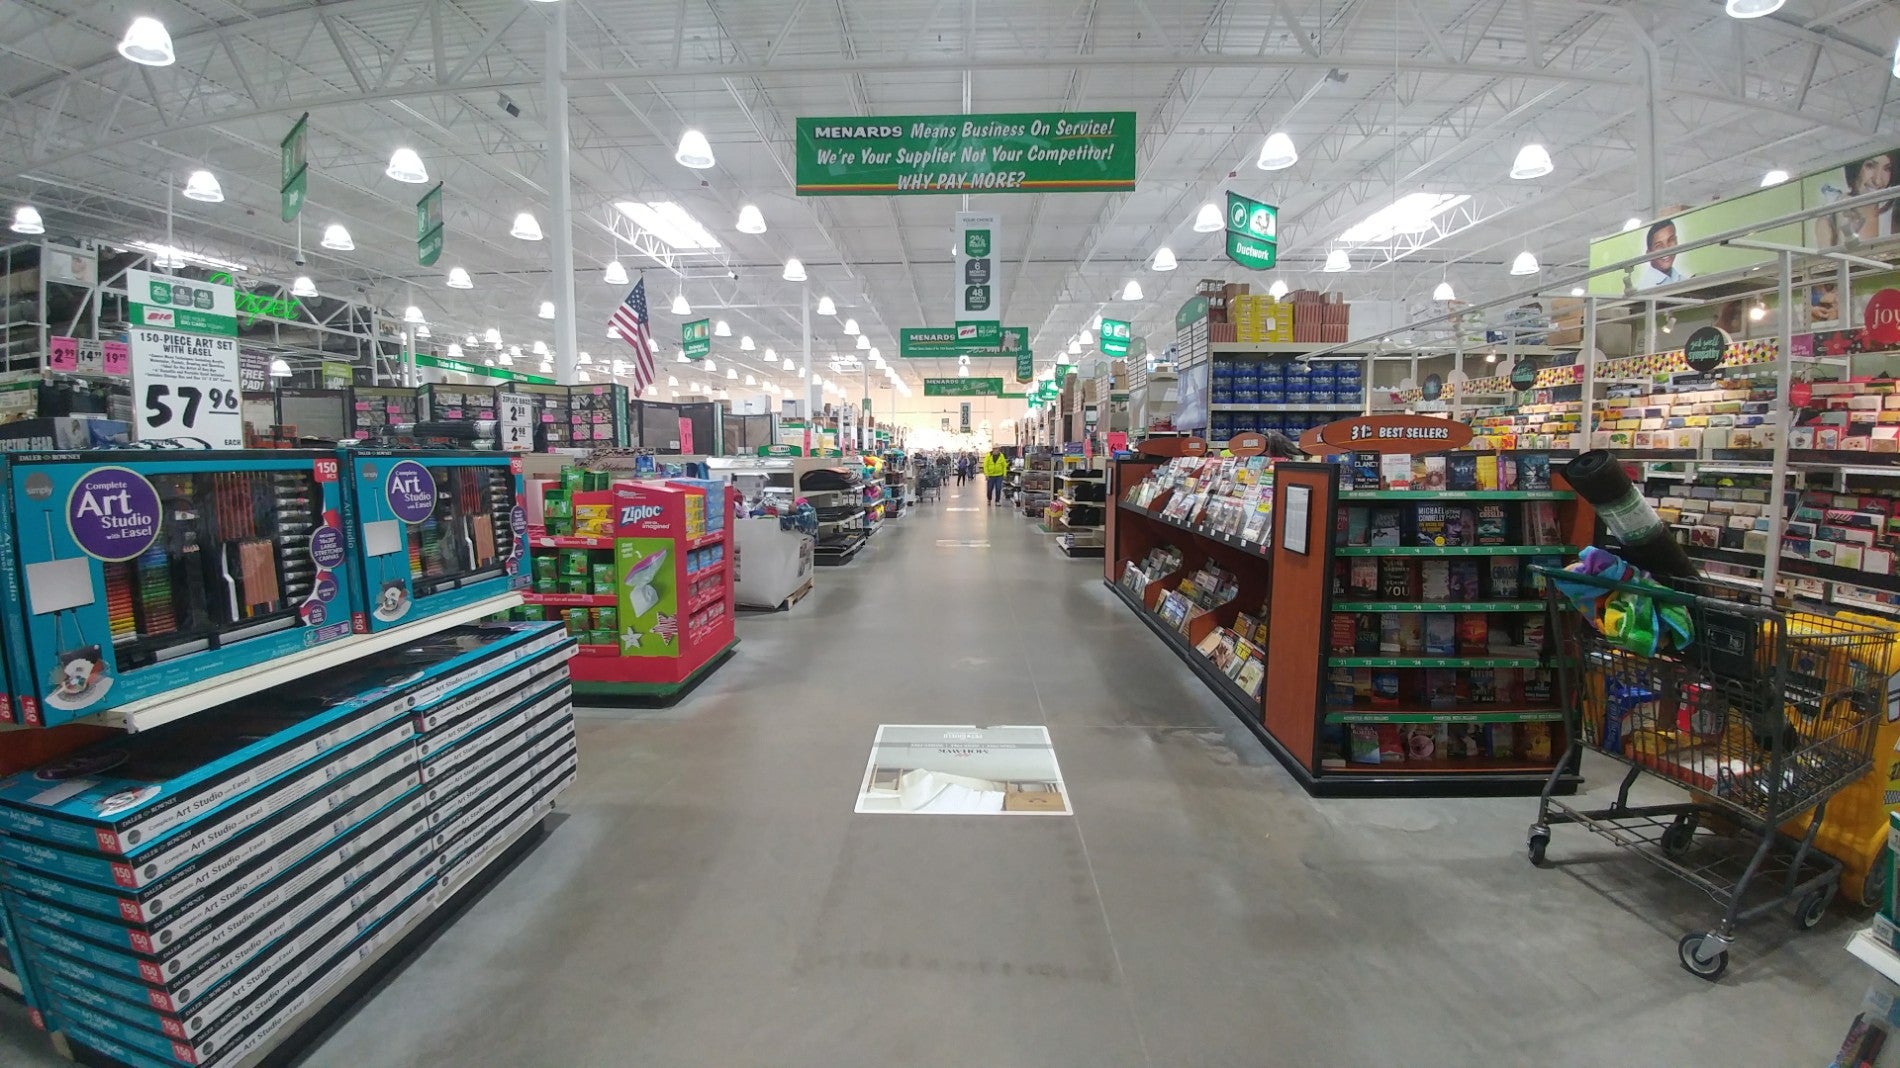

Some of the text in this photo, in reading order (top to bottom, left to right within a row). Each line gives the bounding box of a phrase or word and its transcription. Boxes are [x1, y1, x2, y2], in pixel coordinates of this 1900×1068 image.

[814, 118, 1116, 139] MENARDS Means Business On Service!
[817, 144, 1114, 168] We're Your Supplier Not Your Competitor!
[898, 171, 1026, 190] WHY PAY MORE?
[969, 235, 985, 244] 2%
[1236, 242, 1269, 261] Ductwork
[974, 262, 981, 270] 6
[972, 288, 983, 297] 48
[140, 333, 233, 351] 150-PIECE ART SET
[54, 347, 75, 363] 2 99
[80, 350, 94, 362] 14
[106, 352, 119, 363] 19
[163, 344, 213, 357] WITH EASEL
[240, 368, 265, 380] FREE
[241, 379, 264, 391] PAD!
[146, 384, 238, 429] 57 96
[510, 406, 518, 421] 2
[511, 427, 518, 442] 2
[1378, 427, 1404, 439] BEST
[1406, 427, 1449, 439] SELLERS
[1110, 443, 1117, 453] 6
[52, 453, 81, 461] ROWNEY
[316, 462, 338, 474] 150
[85, 481, 128, 491] Complete
[391, 476, 422, 494] Art
[76, 489, 133, 518] Art
[404, 491, 432, 502] Studio
[415, 501, 432, 509] Easel
[1418, 506, 1445, 515] MICHAEL
[101, 513, 152, 529] Studio
[621, 505, 663, 524] Ziploc
[1418, 514, 1445, 522] CONNELLY
[121, 526, 152, 539] Easel
[345, 519, 355, 549] Studio
[317, 554, 340, 562] CANVAS
[6, 559, 17, 602] Studio
[1384, 586, 1410, 596] YOU
[354, 613, 364, 631] 150
[465, 695, 482, 707] Studio
[457, 721, 474, 733] Studio
[176, 806, 192, 818] Art
[193, 790, 224, 810] Studio
[232, 777, 251, 790] Easel
[122, 797, 177, 828] DALER ROWNEY
[99, 833, 115, 845] 150
[191, 839, 205, 852] Art
[207, 822, 238, 842] Studio
[195, 873, 210, 886] Art
[211, 854, 241, 875] Studio
[248, 838, 266, 853] Easel
[114, 867, 131, 879] 150
[144, 864, 196, 899] DALER ROWNEY
[204, 867, 273, 915] Art Studio Easel
[121, 902, 138, 915] 150
[211, 895, 279, 945] Art Studio Easel
[131, 934, 148, 948] 150
[140, 964, 158, 978] 150
[150, 993, 168, 1007] 150
[163, 1020, 180, 1034] 150
